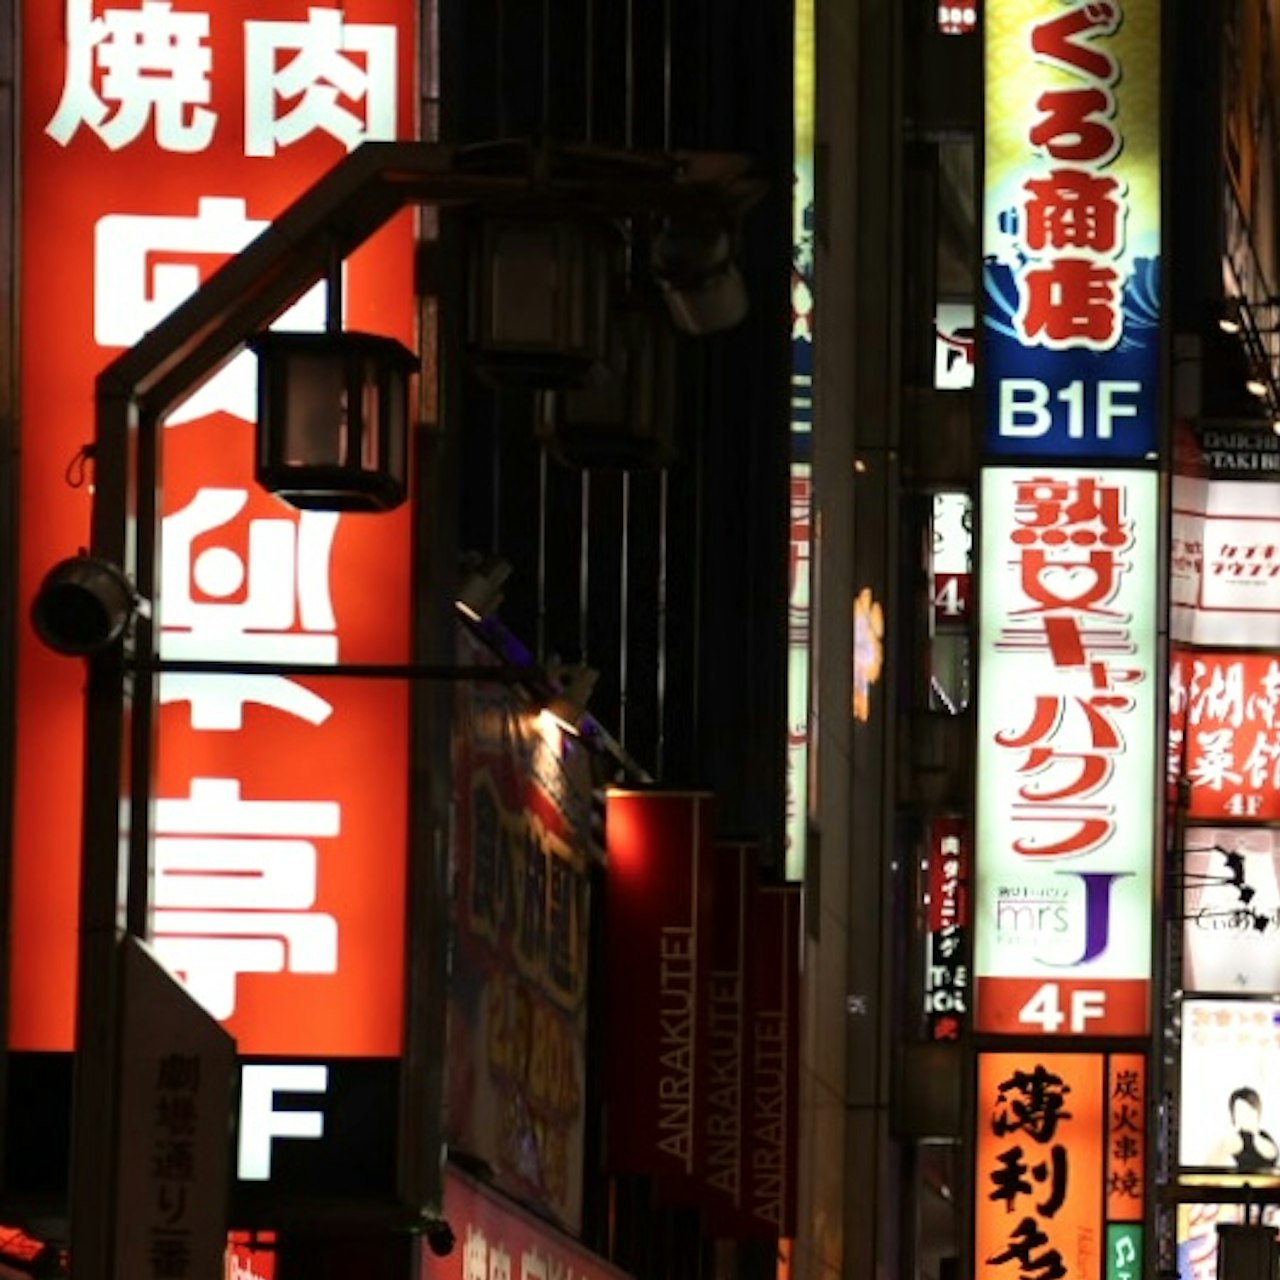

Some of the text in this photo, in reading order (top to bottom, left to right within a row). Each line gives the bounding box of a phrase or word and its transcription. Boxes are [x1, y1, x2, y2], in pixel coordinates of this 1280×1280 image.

[45, 0, 398, 156] 焼肉
[1000, 380, 1141, 439] B1F
[994, 477, 1145, 857] 熟女キャバクラ
[655, 926, 694, 1161] ANRAKUTEI
[705, 970, 740, 1200] ANRAKUTEI
[1019, 984, 1107, 1034] 4F
[752, 1009, 784, 1226] ANRAKUTEI
[1109, 1070, 1143, 1198] 炭火串焼
